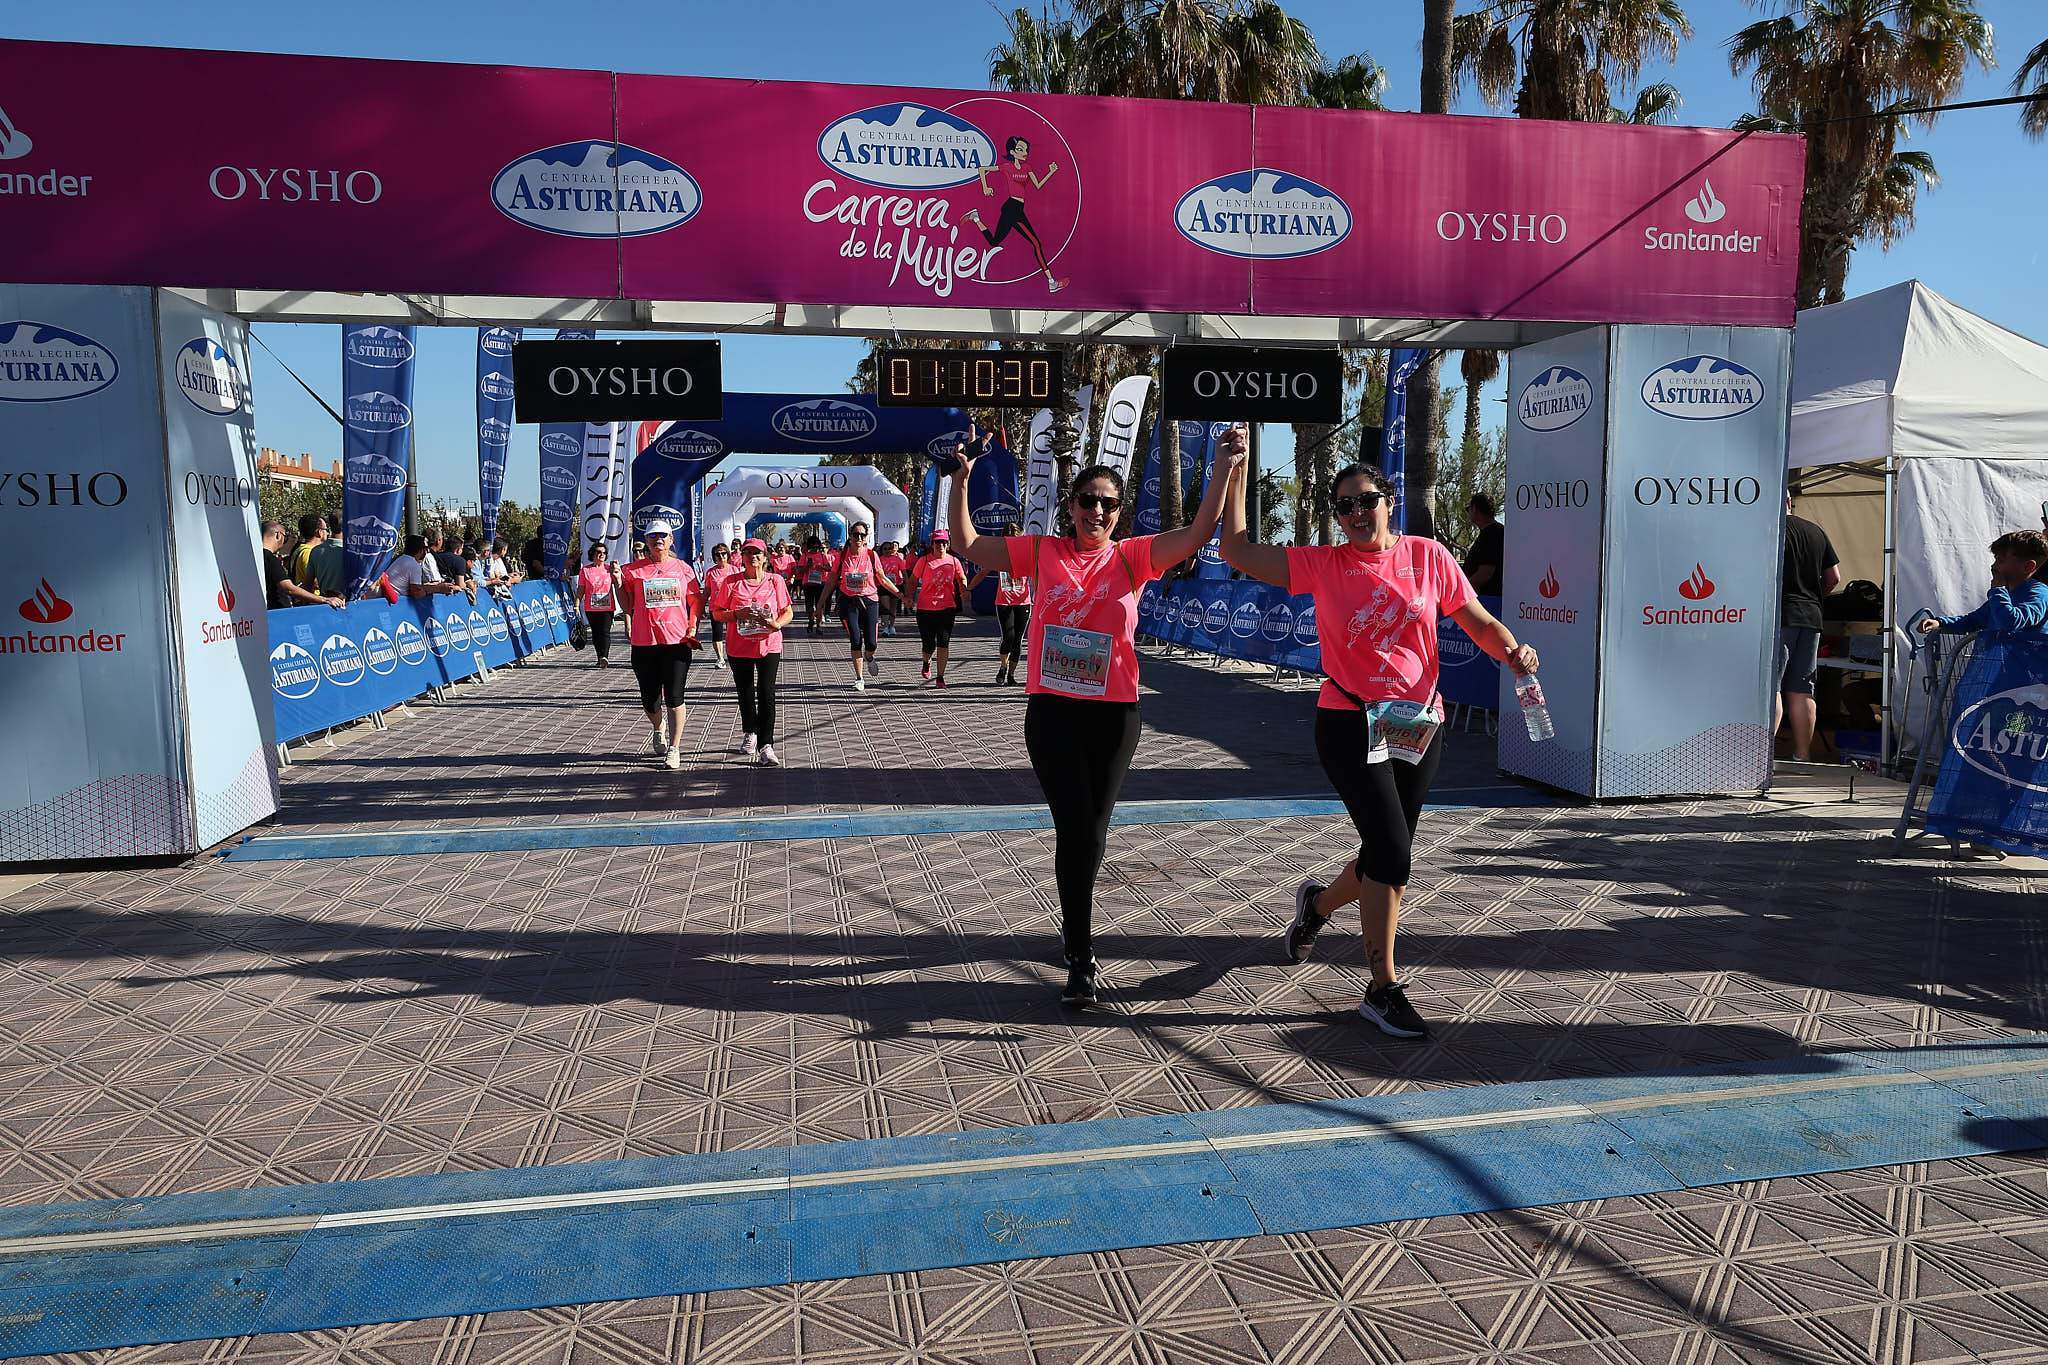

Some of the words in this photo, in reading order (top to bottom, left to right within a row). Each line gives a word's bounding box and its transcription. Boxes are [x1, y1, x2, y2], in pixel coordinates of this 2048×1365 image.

[832, 131, 983, 169] ASTURIANA
[859, 130, 916, 142] CENTRAL
[921, 133, 978, 145] LECHERA
[209, 166, 382, 204] OYSHO
[540, 172, 606, 184] CENTRAL
[613, 175, 679, 186] LECHERA
[508, 173, 687, 214] ASTURIANA
[803, 180, 951, 230] Carrera
[1216, 198, 1272, 209] CENTRAL
[1276, 201, 1333, 211] LECHERA
[1188, 199, 1339, 237] ASTURIANA
[1436, 211, 1567, 244] OYSHO
[1644, 226, 1762, 253] Santander
[840, 228, 867, 258] de
[873, 228, 893, 260] la
[888, 225, 1003, 297] Mujer
[40, 350, 98, 358] LECHERA
[182, 358, 241, 401] ASTURIANA
[549, 366, 693, 396] OYSHO
[1193, 370, 1318, 400] OYSHO
[1649, 379, 1755, 404] ASTURIANA
[1669, 377, 1708, 385] CENTRAL
[1522, 393, 1587, 419] ASTURIANA
[780, 413, 870, 433] ASTURIANA
[184, 471, 251, 509] OYSHO
[584, 422, 611, 542] OYSH
[767, 472, 848, 490] OYSHO
[1634, 476, 1761, 507] OYSHO
[1515, 479, 1589, 511] OYSHO
[1519, 601, 1579, 625] Santander
[1642, 605, 1747, 626] Santander
[202, 619, 254, 644] Santander
[272, 666, 318, 688] ASTURIANA
[324, 655, 363, 676] ASTURIANA
